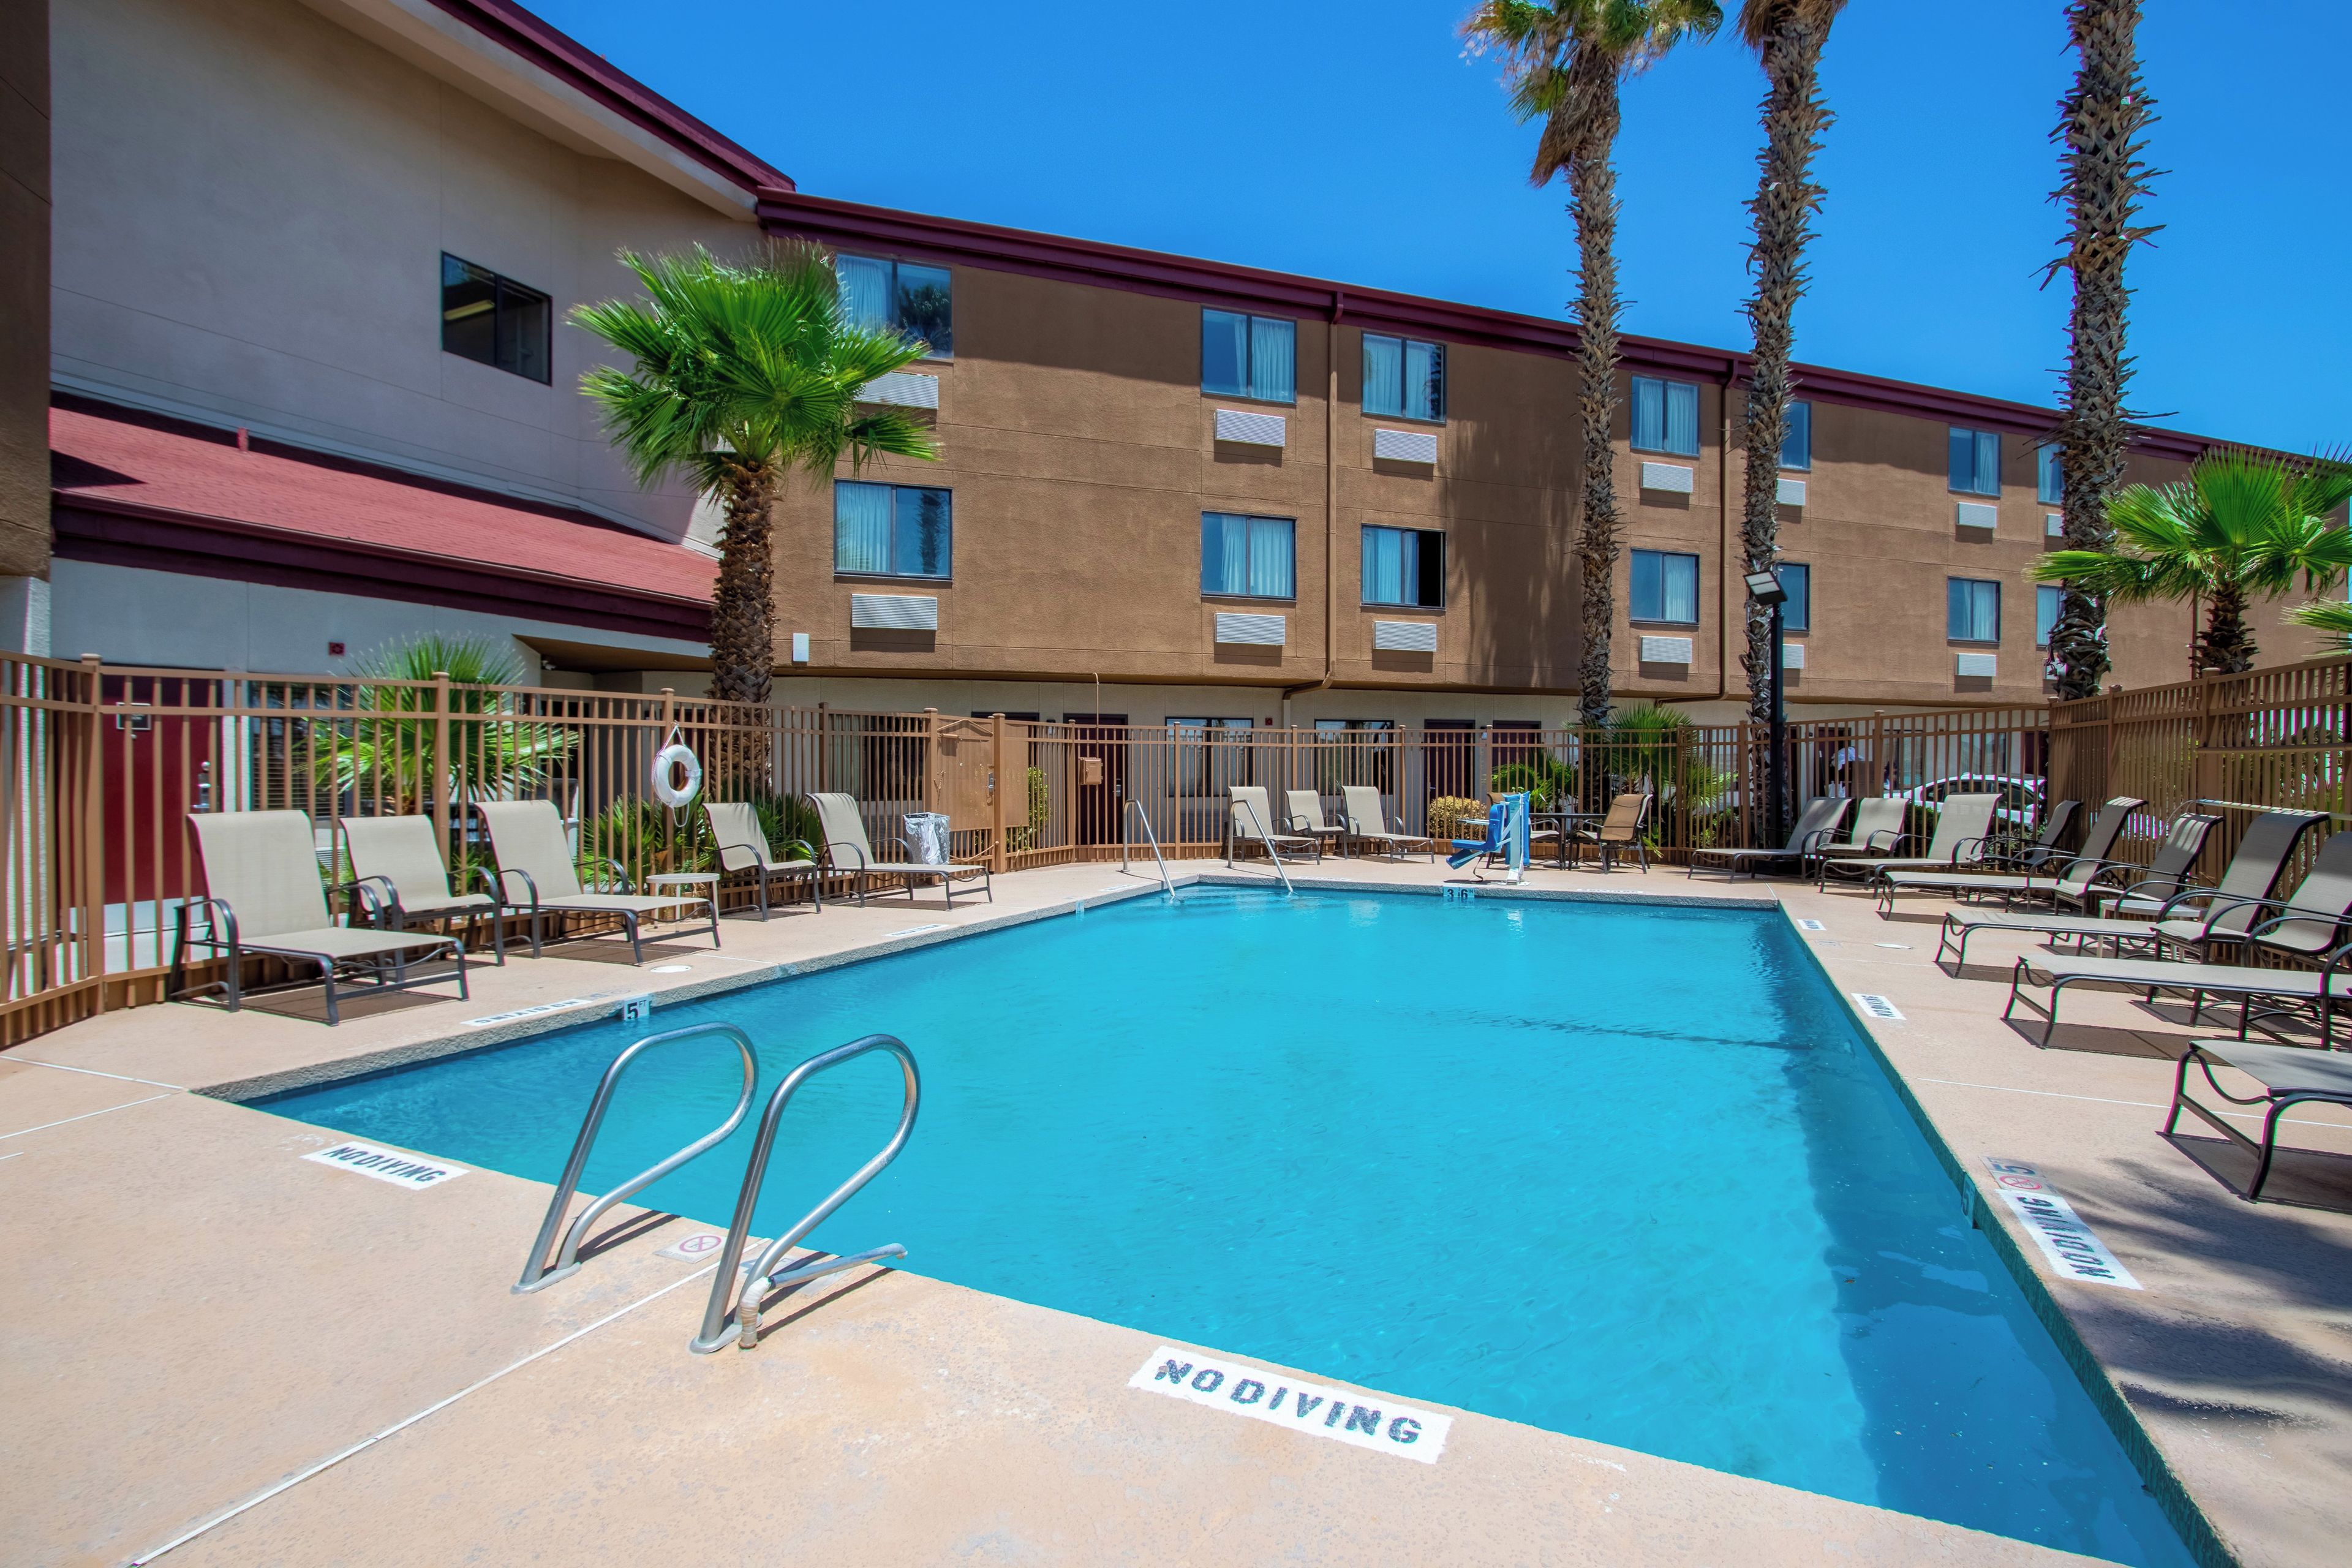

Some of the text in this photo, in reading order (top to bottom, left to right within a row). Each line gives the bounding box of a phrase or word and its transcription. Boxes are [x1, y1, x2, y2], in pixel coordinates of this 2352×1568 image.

[627, 1002, 638, 1020] 5
[322, 1147, 447, 1182] NO DIVING
[2015, 1196, 2116, 1279] NO DIVING
[1155, 1359, 1422, 1444] NO DIVING
